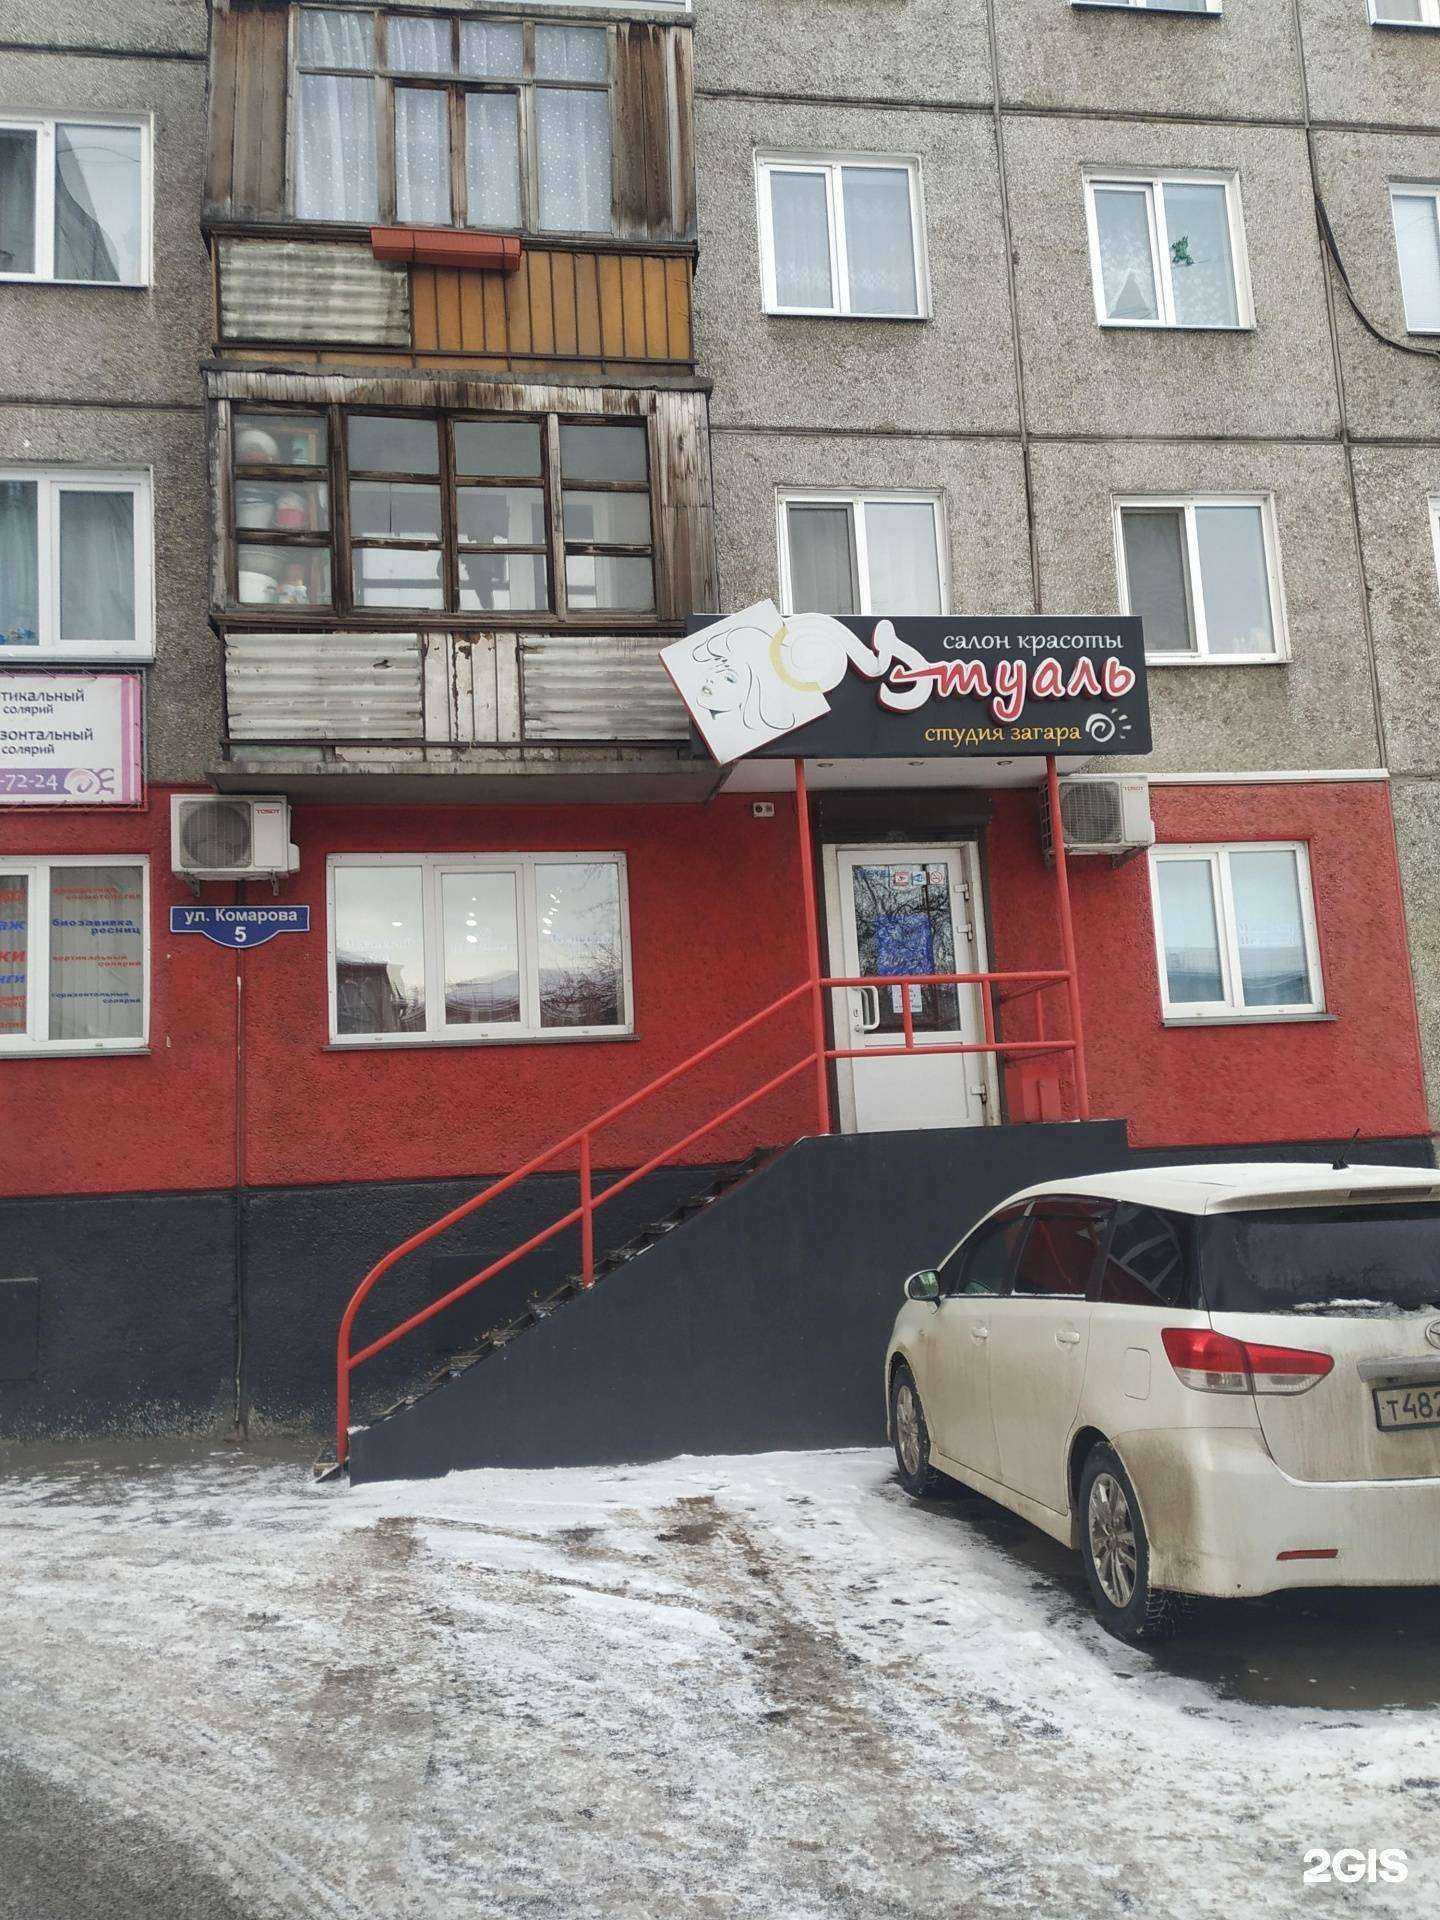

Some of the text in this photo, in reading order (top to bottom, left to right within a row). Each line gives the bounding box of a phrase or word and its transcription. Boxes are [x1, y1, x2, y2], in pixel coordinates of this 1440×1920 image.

[943, 634, 1124, 656] салон красоты
[3, 704, 54, 716] солярий
[924, 726, 1082, 747] студия загара
[1, 744, 55, 757] солярий
[184, 908, 298, 925] ул. Комарова
[234, 926, 247, 942] 5
